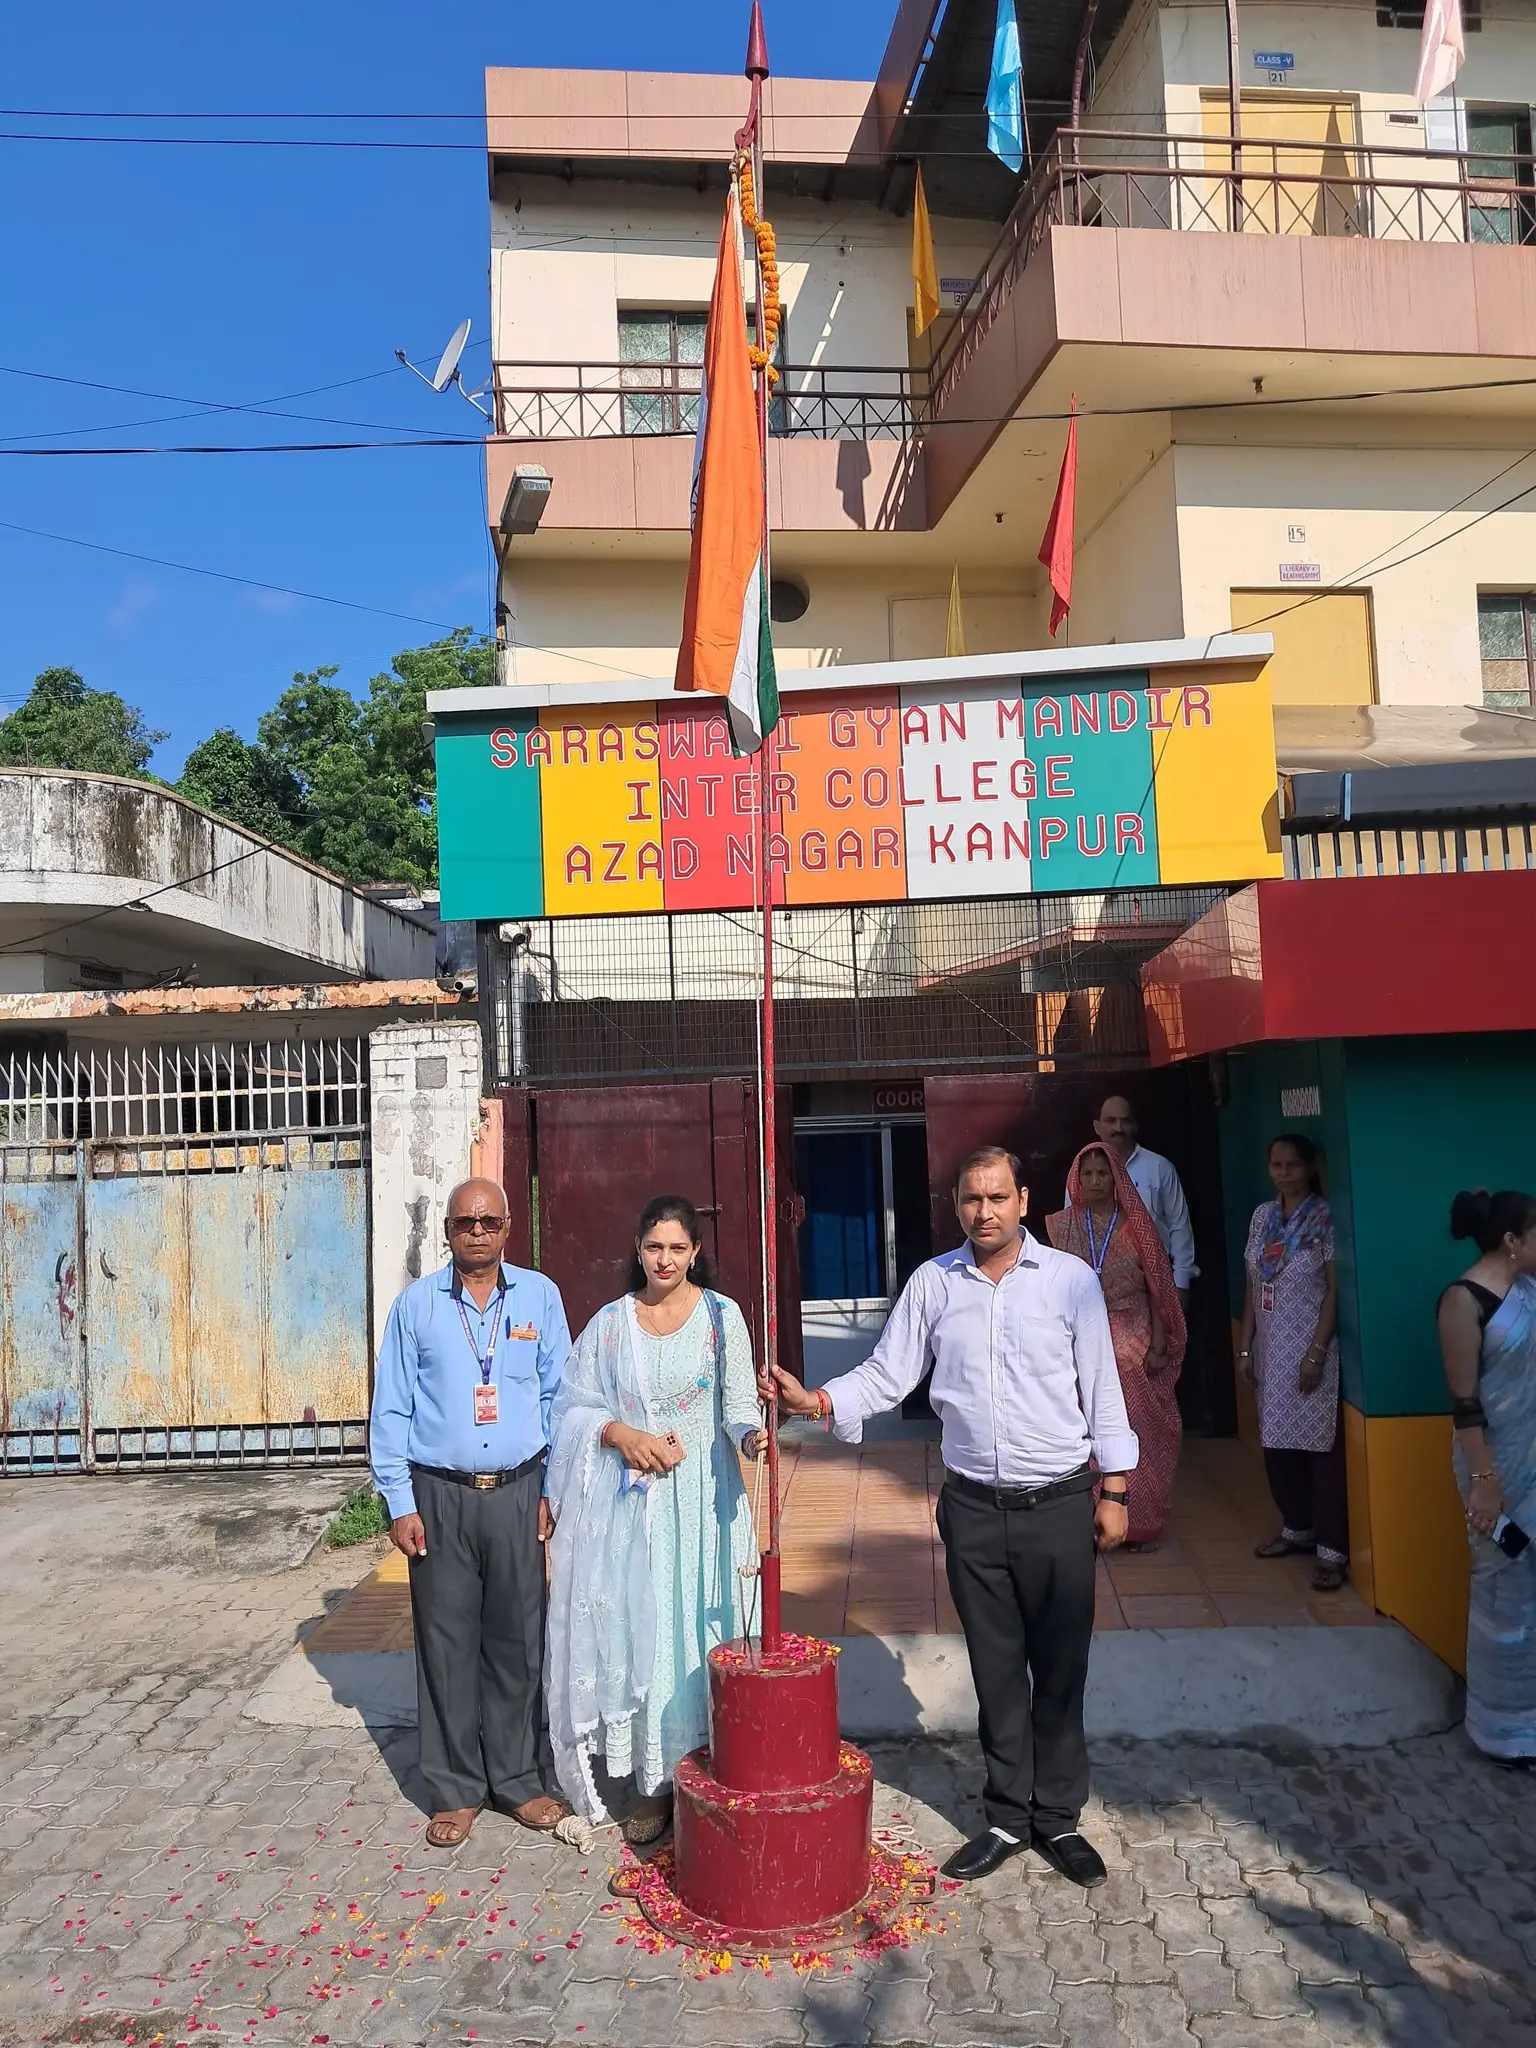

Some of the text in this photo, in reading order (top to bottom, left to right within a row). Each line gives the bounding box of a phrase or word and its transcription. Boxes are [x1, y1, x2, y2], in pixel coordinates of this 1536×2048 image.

[1256, 56, 1280, 64] CLASS
[1271, 73, 1284, 82] 21
[1291, 527, 1303, 539] 15
[489, 684, 1213, 768] SARASWAI GYAN MANDIR
[625, 754, 1075, 823] INTER COLLEGE
[564, 812, 1145, 885] AZAD NAGAR KANPUR
